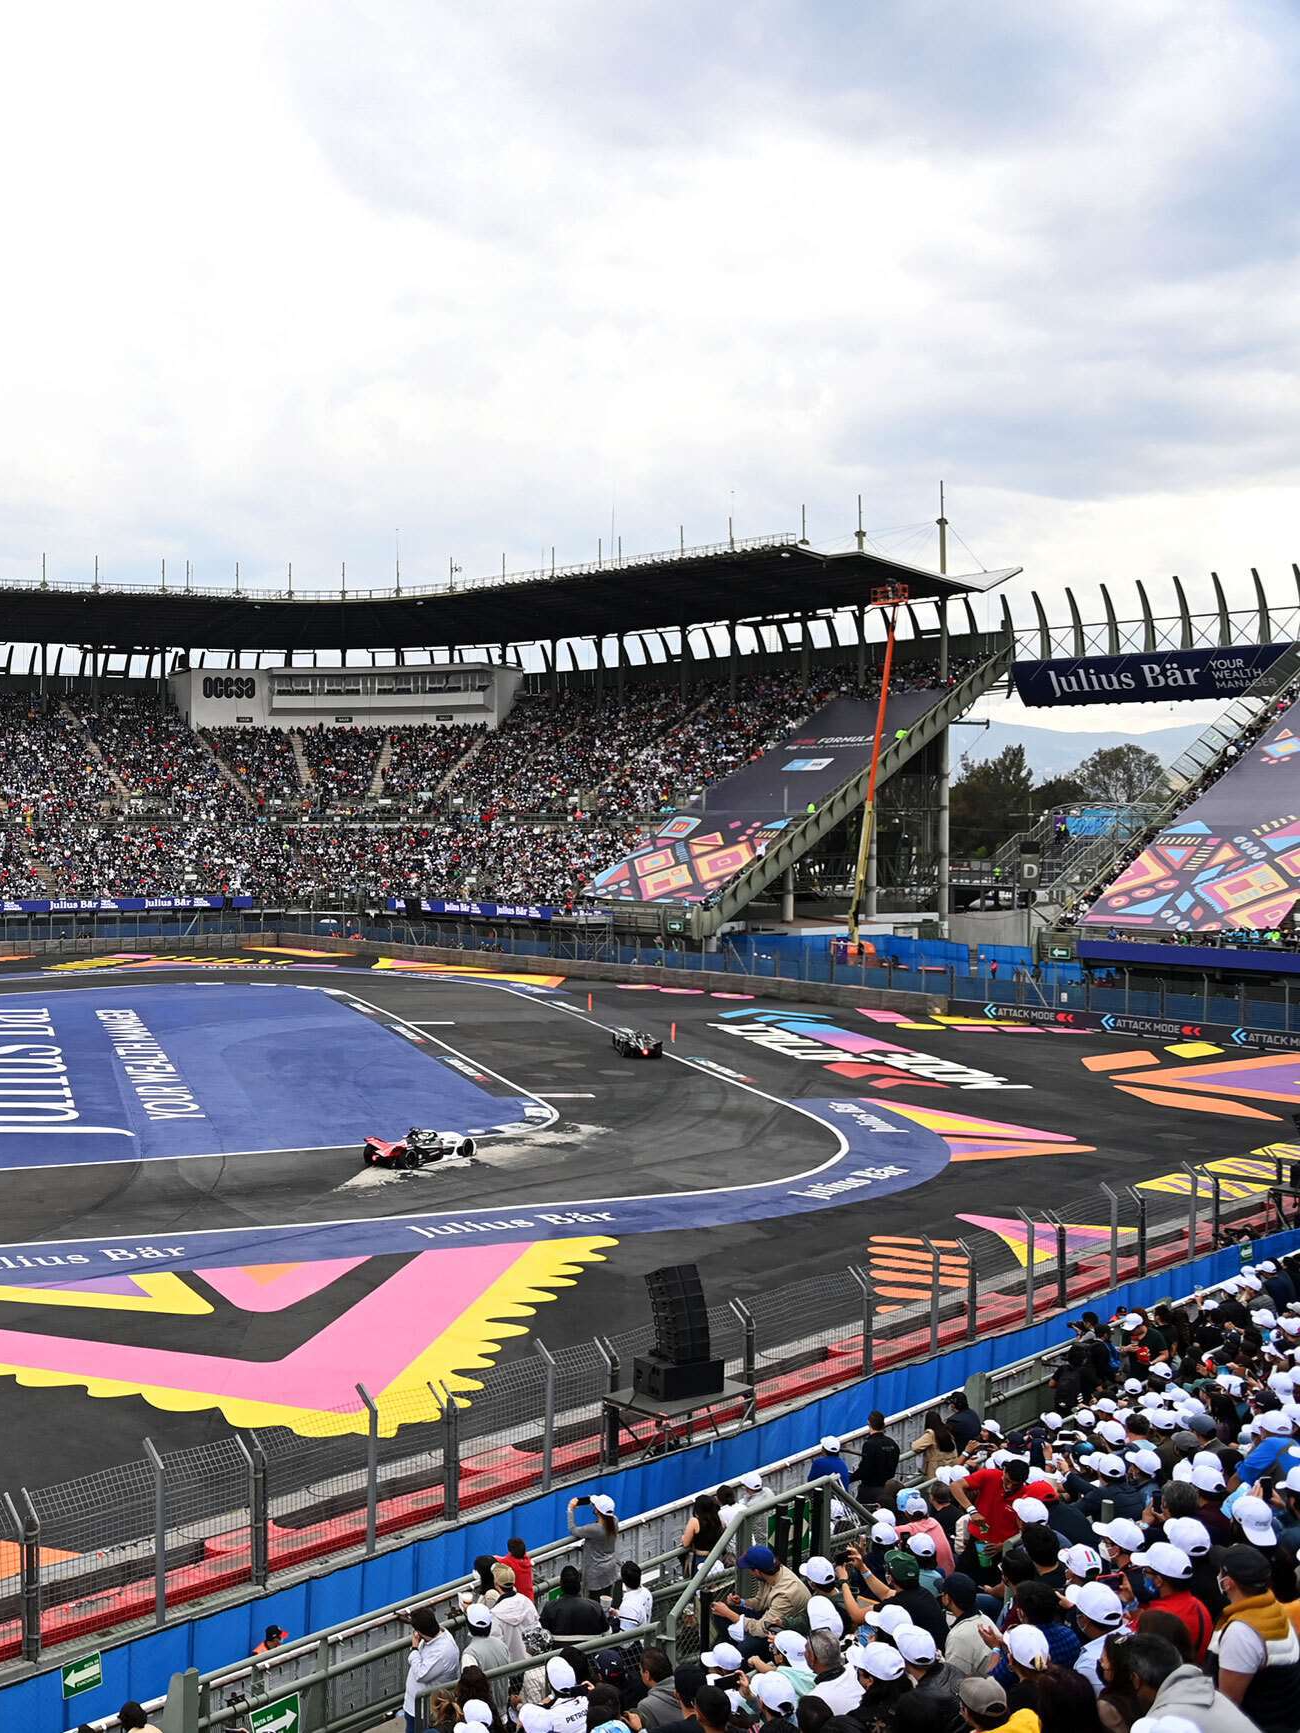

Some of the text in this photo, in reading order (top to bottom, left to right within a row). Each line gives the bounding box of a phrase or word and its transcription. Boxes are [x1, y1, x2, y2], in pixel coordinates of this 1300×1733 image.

[1209, 658, 1245, 670] YOUR
[1048, 662, 1200, 698] Julius Bär
[1211, 668, 1262, 679] WEALTH
[1215, 677, 1277, 688] MANAGER
[1023, 864, 1038, 879] D
[50, 900, 78, 910] Julius
[80, 900, 98, 909] Bär
[145, 898, 171, 908] Julius
[174, 898, 191, 907] Bär
[998, 1007, 1055, 1021] ATTACK MODE
[1116, 1018, 1181, 1034] ATTACK MODE
[1248, 1033, 1289, 1045] ATTACK
[95, 1009, 206, 1120] YOUR WEALTH MANAGER
[787, 1164, 910, 1200] Julius Bär
[405, 1208, 618, 1240] Julius Bär
[99, 1243, 186, 1263] Bär
